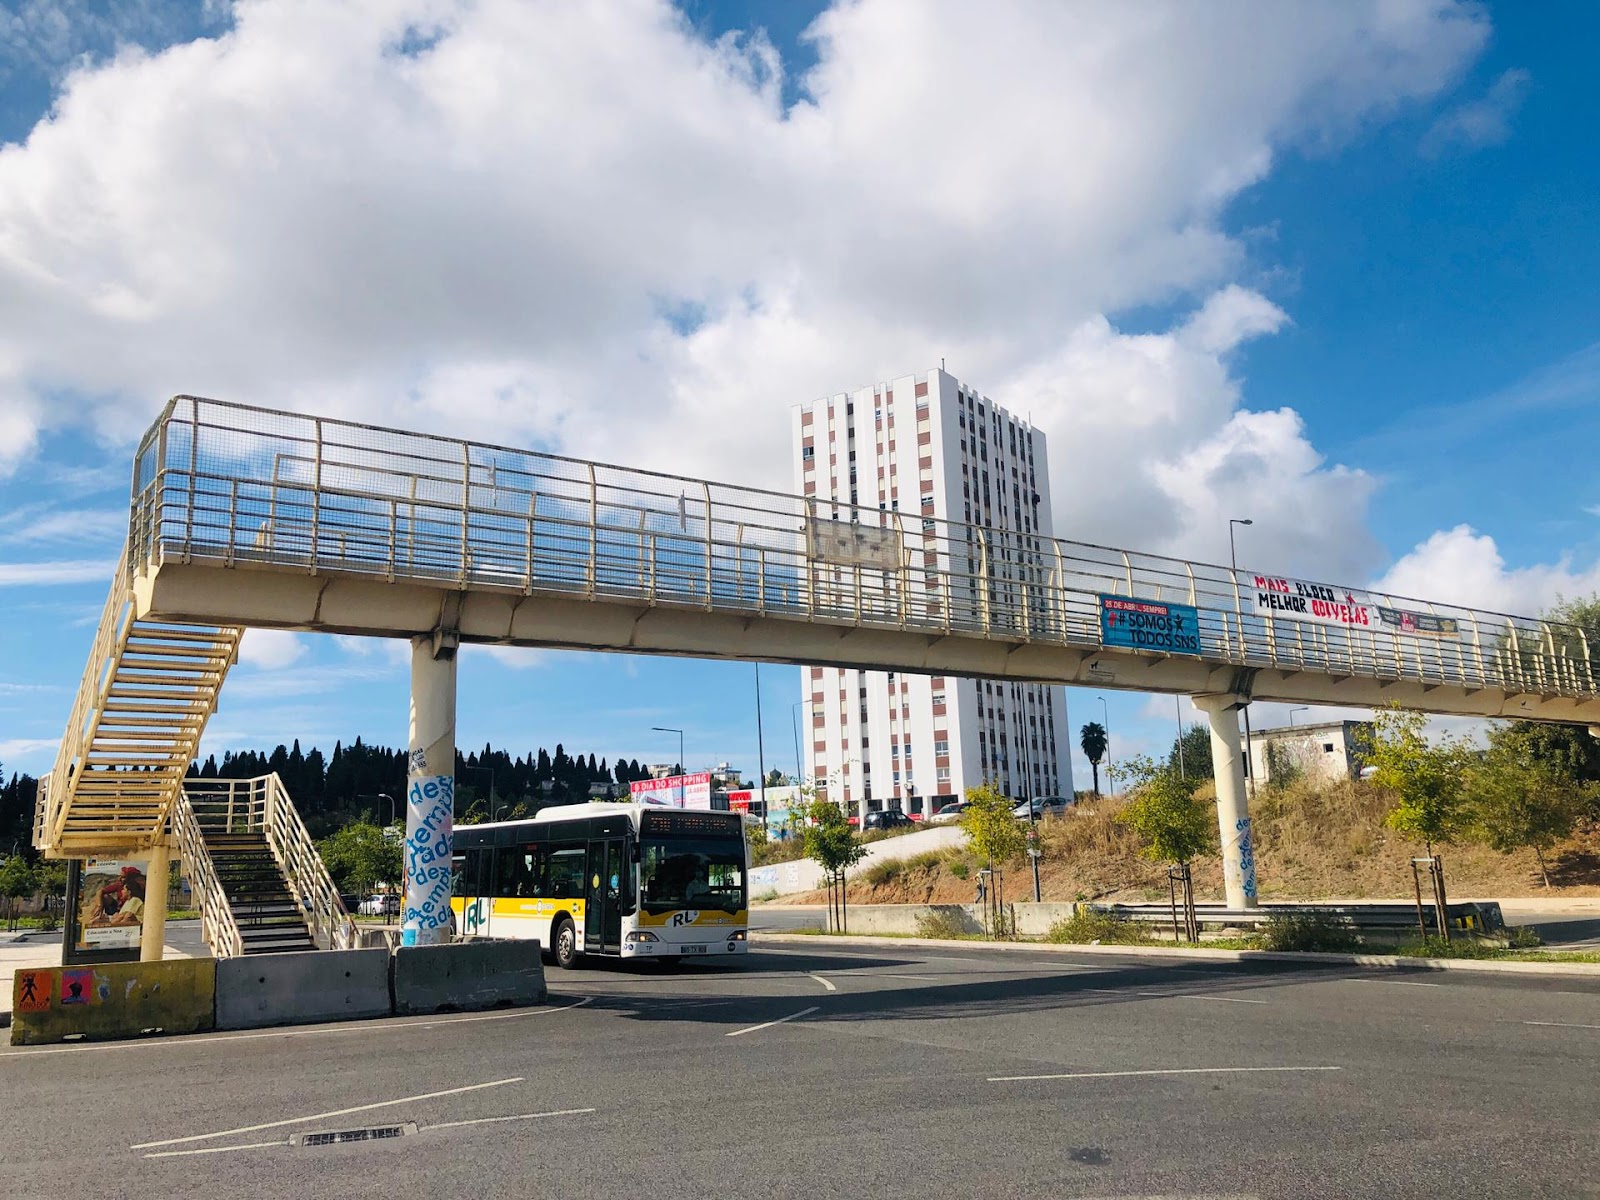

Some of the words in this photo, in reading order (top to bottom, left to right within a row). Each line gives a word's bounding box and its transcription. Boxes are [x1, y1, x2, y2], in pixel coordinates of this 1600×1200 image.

[1254, 575, 1289, 593] MAIS
[1295, 582, 1335, 602] BLOCO
[1104, 600, 1112, 608] 25
[1113, 601, 1122, 609] DE
[1143, 605, 1168, 615] SEMPRE!
[1258, 593, 1307, 613] MELHOR
[1311, 599, 1368, 625] ODIVELAS
[1129, 629, 1172, 646] TODOS
[1174, 634, 1197, 649] SNS
[641, 780, 654, 791] DIA
[655, 779, 667, 789] DO
[668, 774, 707, 788] SHOPPING
[467, 899, 485, 932] RL
[673, 911, 693, 927] RL
